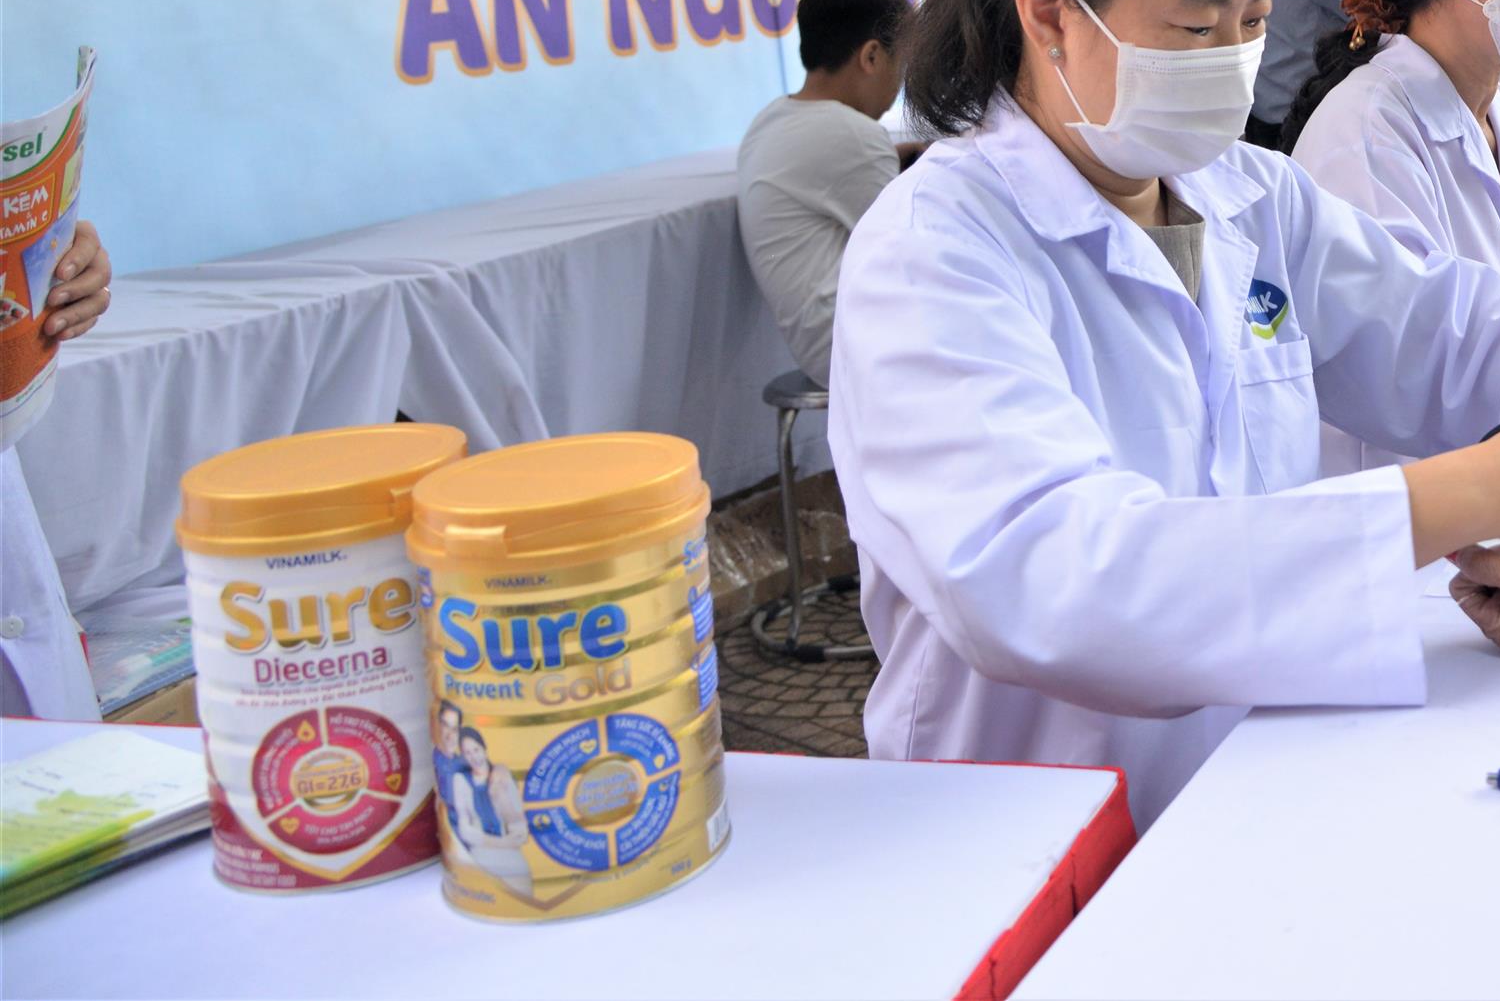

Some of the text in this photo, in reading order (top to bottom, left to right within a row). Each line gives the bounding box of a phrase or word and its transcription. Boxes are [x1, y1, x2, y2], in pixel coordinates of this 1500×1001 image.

[265, 550, 343, 570] VINAMILK
[485, 575, 548, 590] VINAMILK
[219, 576, 416, 654] Sure
[438, 596, 629, 672] Sure
[254, 646, 388, 684] Diecerna
[443, 657, 633, 707] Prevent Gold
